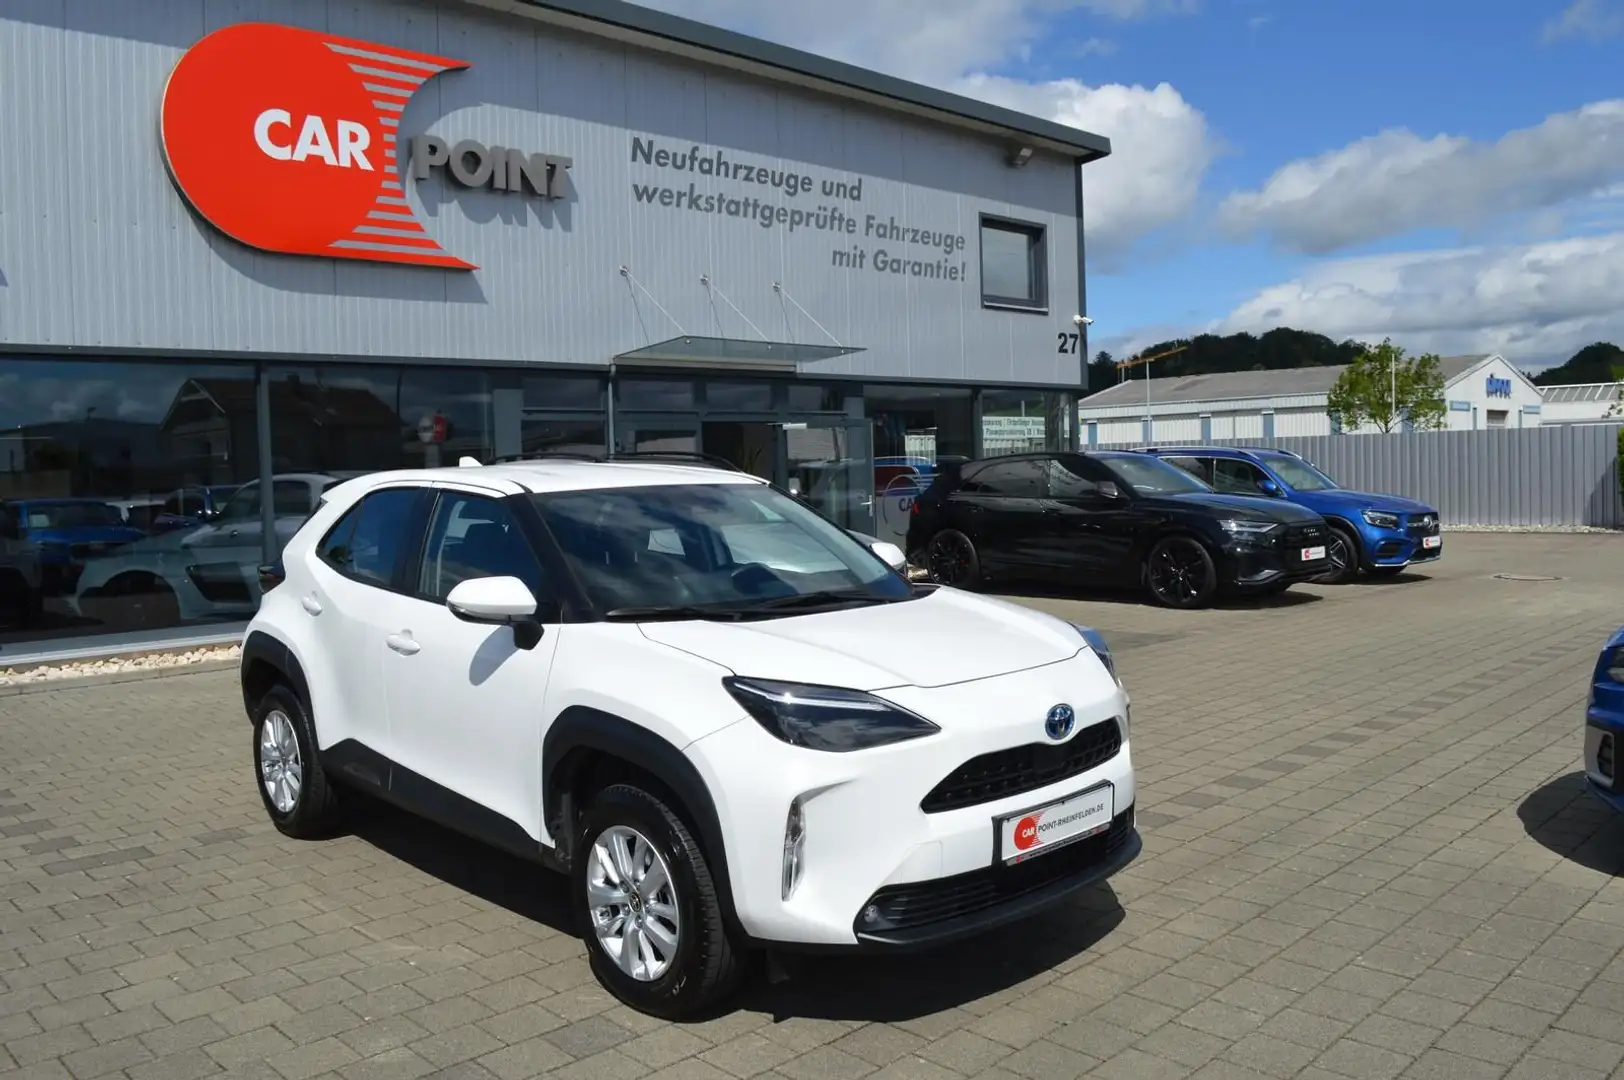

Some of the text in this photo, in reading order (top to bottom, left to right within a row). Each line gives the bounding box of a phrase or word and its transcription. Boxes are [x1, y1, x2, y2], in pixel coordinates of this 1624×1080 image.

[254, 108, 573, 199] CAR POINT
[631, 137, 862, 201] Neufahrzeuge und
[633, 183, 966, 253] werkstattgeprüfte Fahrzeuge
[832, 244, 967, 282] mit Garantie!
[1057, 332, 1079, 355] 27
[899, 497, 913, 512] CA
[1022, 803, 1104, 838] CAR POINT-RHEINFELDEN.DE
